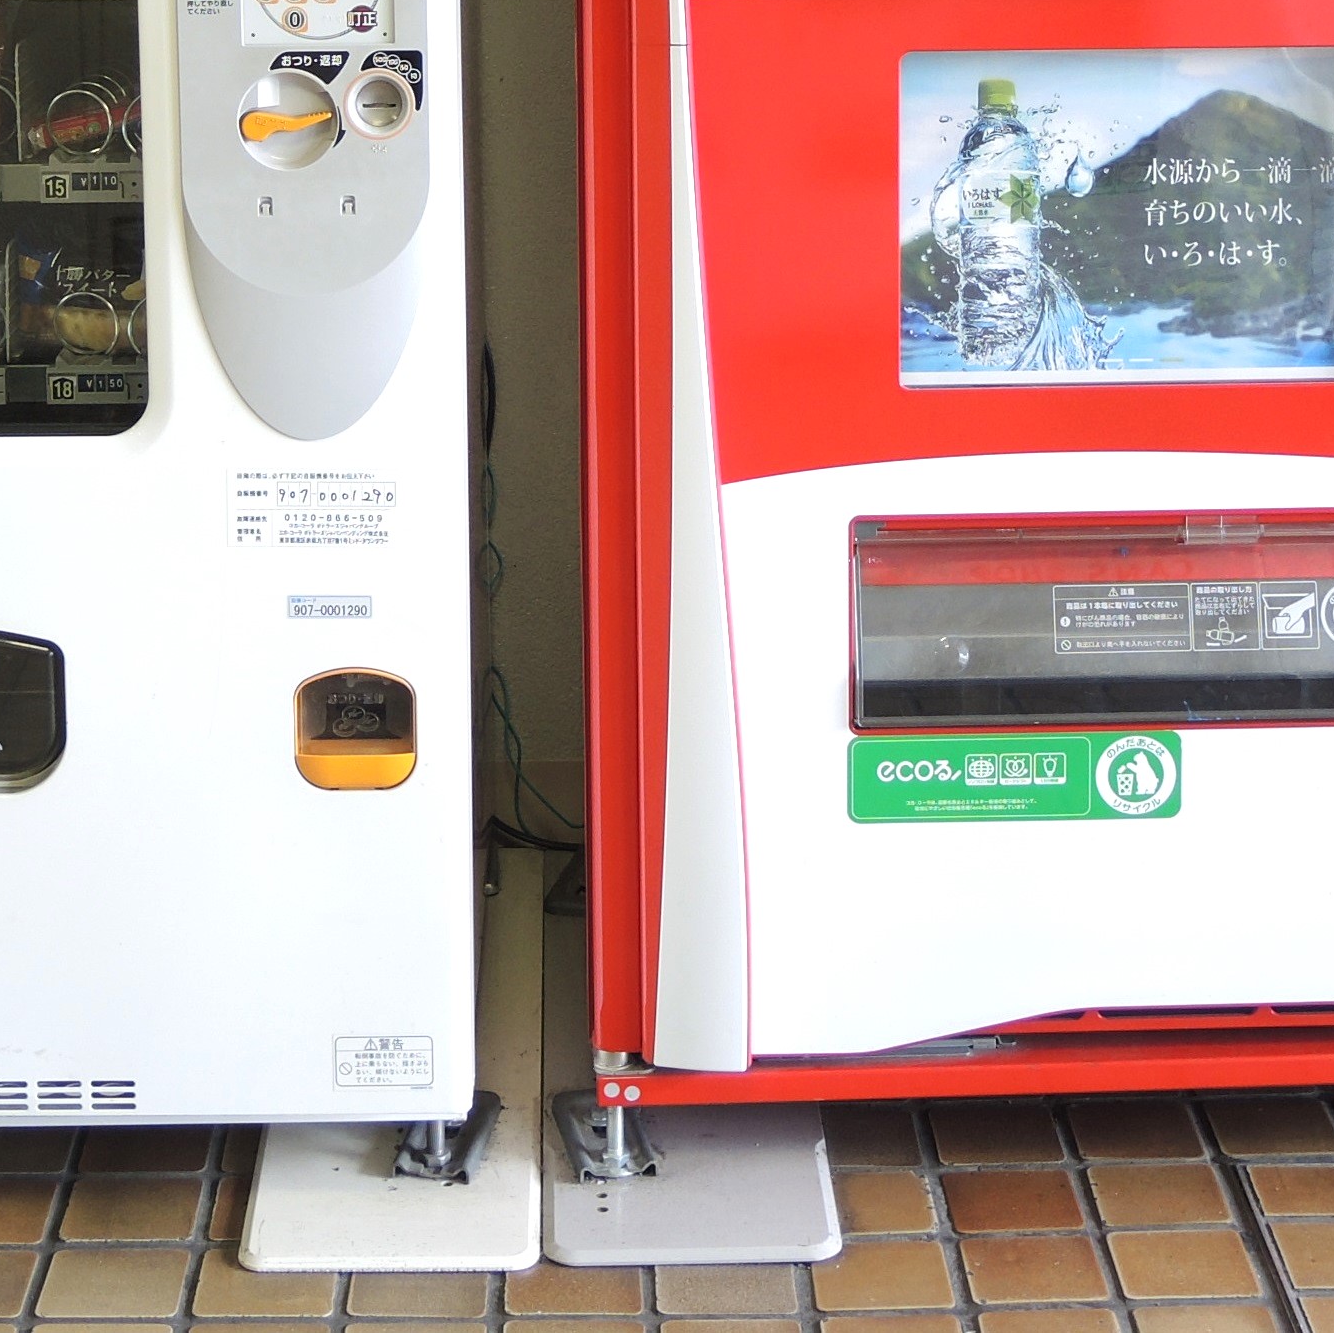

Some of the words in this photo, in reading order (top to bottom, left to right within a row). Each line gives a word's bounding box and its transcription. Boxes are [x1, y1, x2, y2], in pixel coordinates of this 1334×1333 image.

[289, 12, 300, 28] 0
[347, 12, 377, 27] 訂正
[281, 56, 343, 67] おつり・返却
[46, 178, 65, 196] 15
[962, 188, 1003, 202] いろはす
[1143, 199, 1305, 227] 育ちのいい水、
[1143, 241, 1289, 267] い・ろ・は・す。
[54, 380, 73, 398] 18
[294, 605, 367, 616] 907-0001290
[1106, 738, 1166, 758] のんだあとは
[1112, 797, 1162, 812] リサイクル
